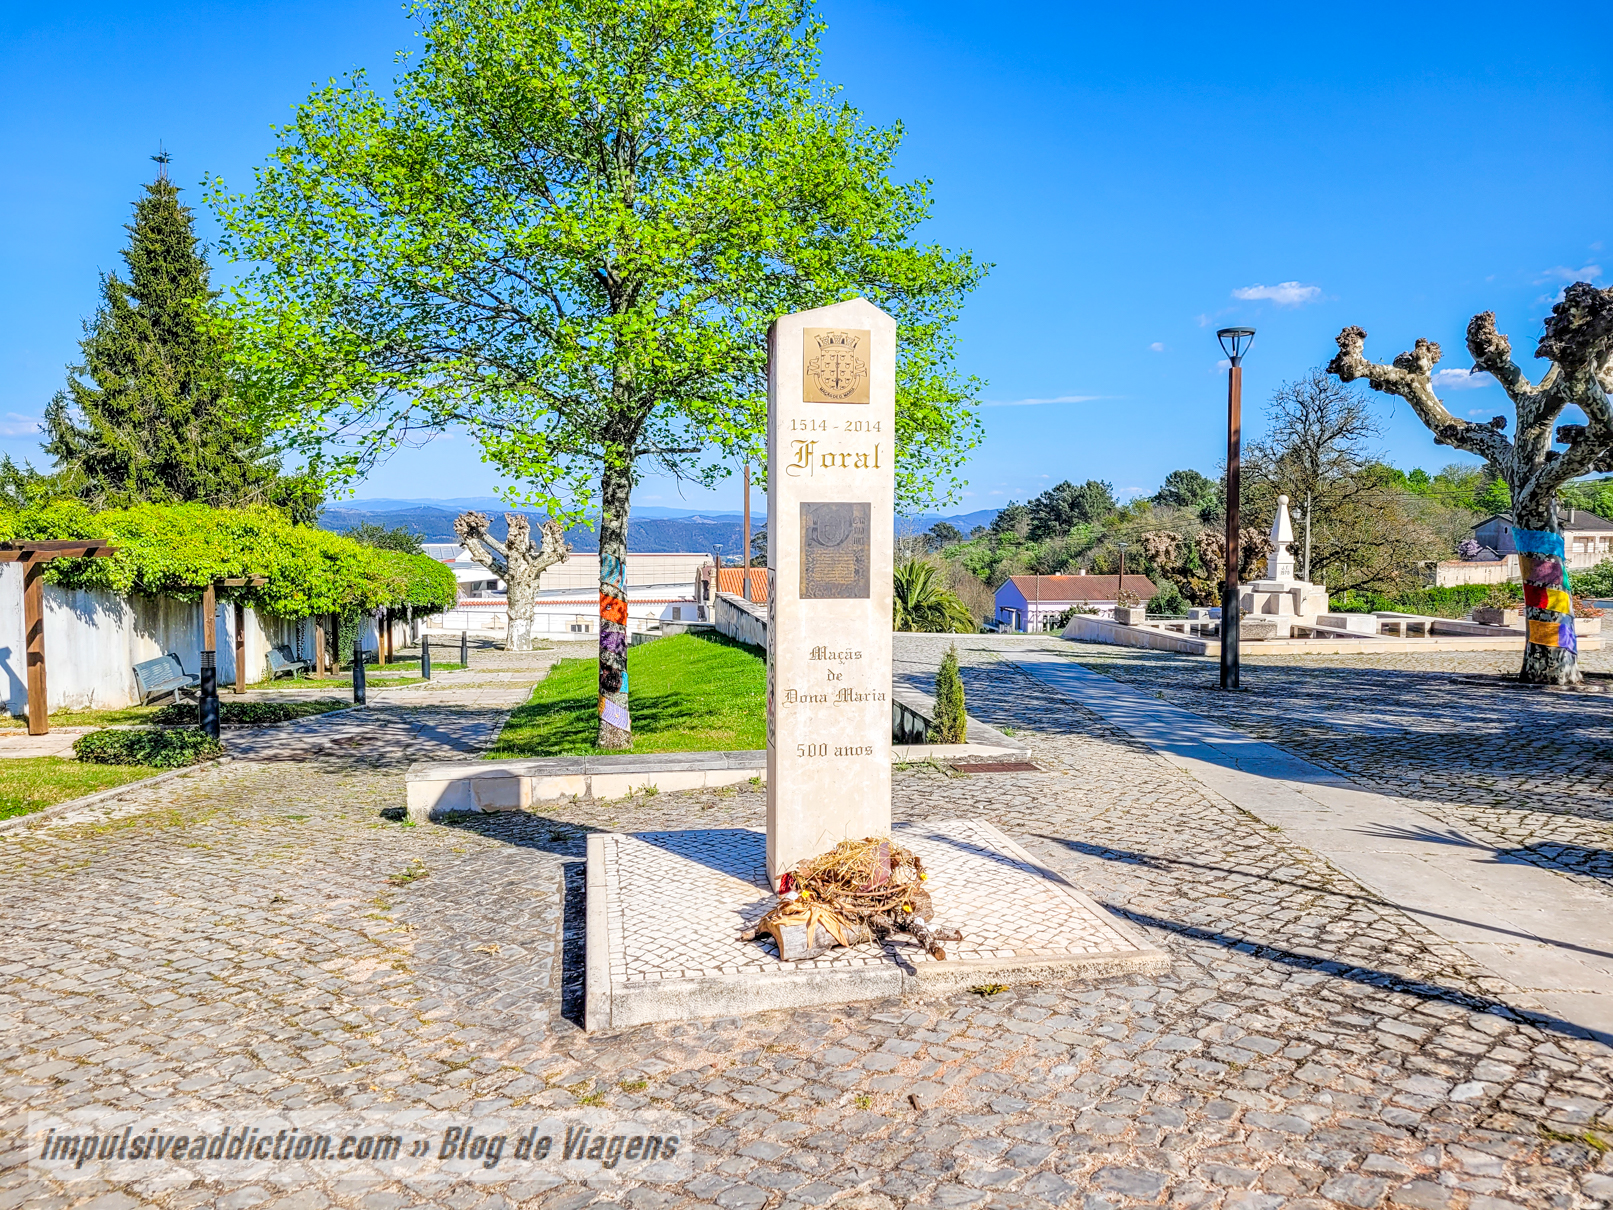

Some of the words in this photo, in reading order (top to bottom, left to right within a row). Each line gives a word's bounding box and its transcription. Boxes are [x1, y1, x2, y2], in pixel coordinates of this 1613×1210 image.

[790, 418, 828, 432] 1514
[844, 419, 882, 433] 2014
[785, 439, 883, 478] Foral
[808, 645, 863, 665] Maçãs
[826, 669, 843, 682] de
[781, 688, 828, 709] Dona
[832, 687, 886, 708] Maria
[796, 742, 828, 758] 500
[833, 744, 874, 758] anos
